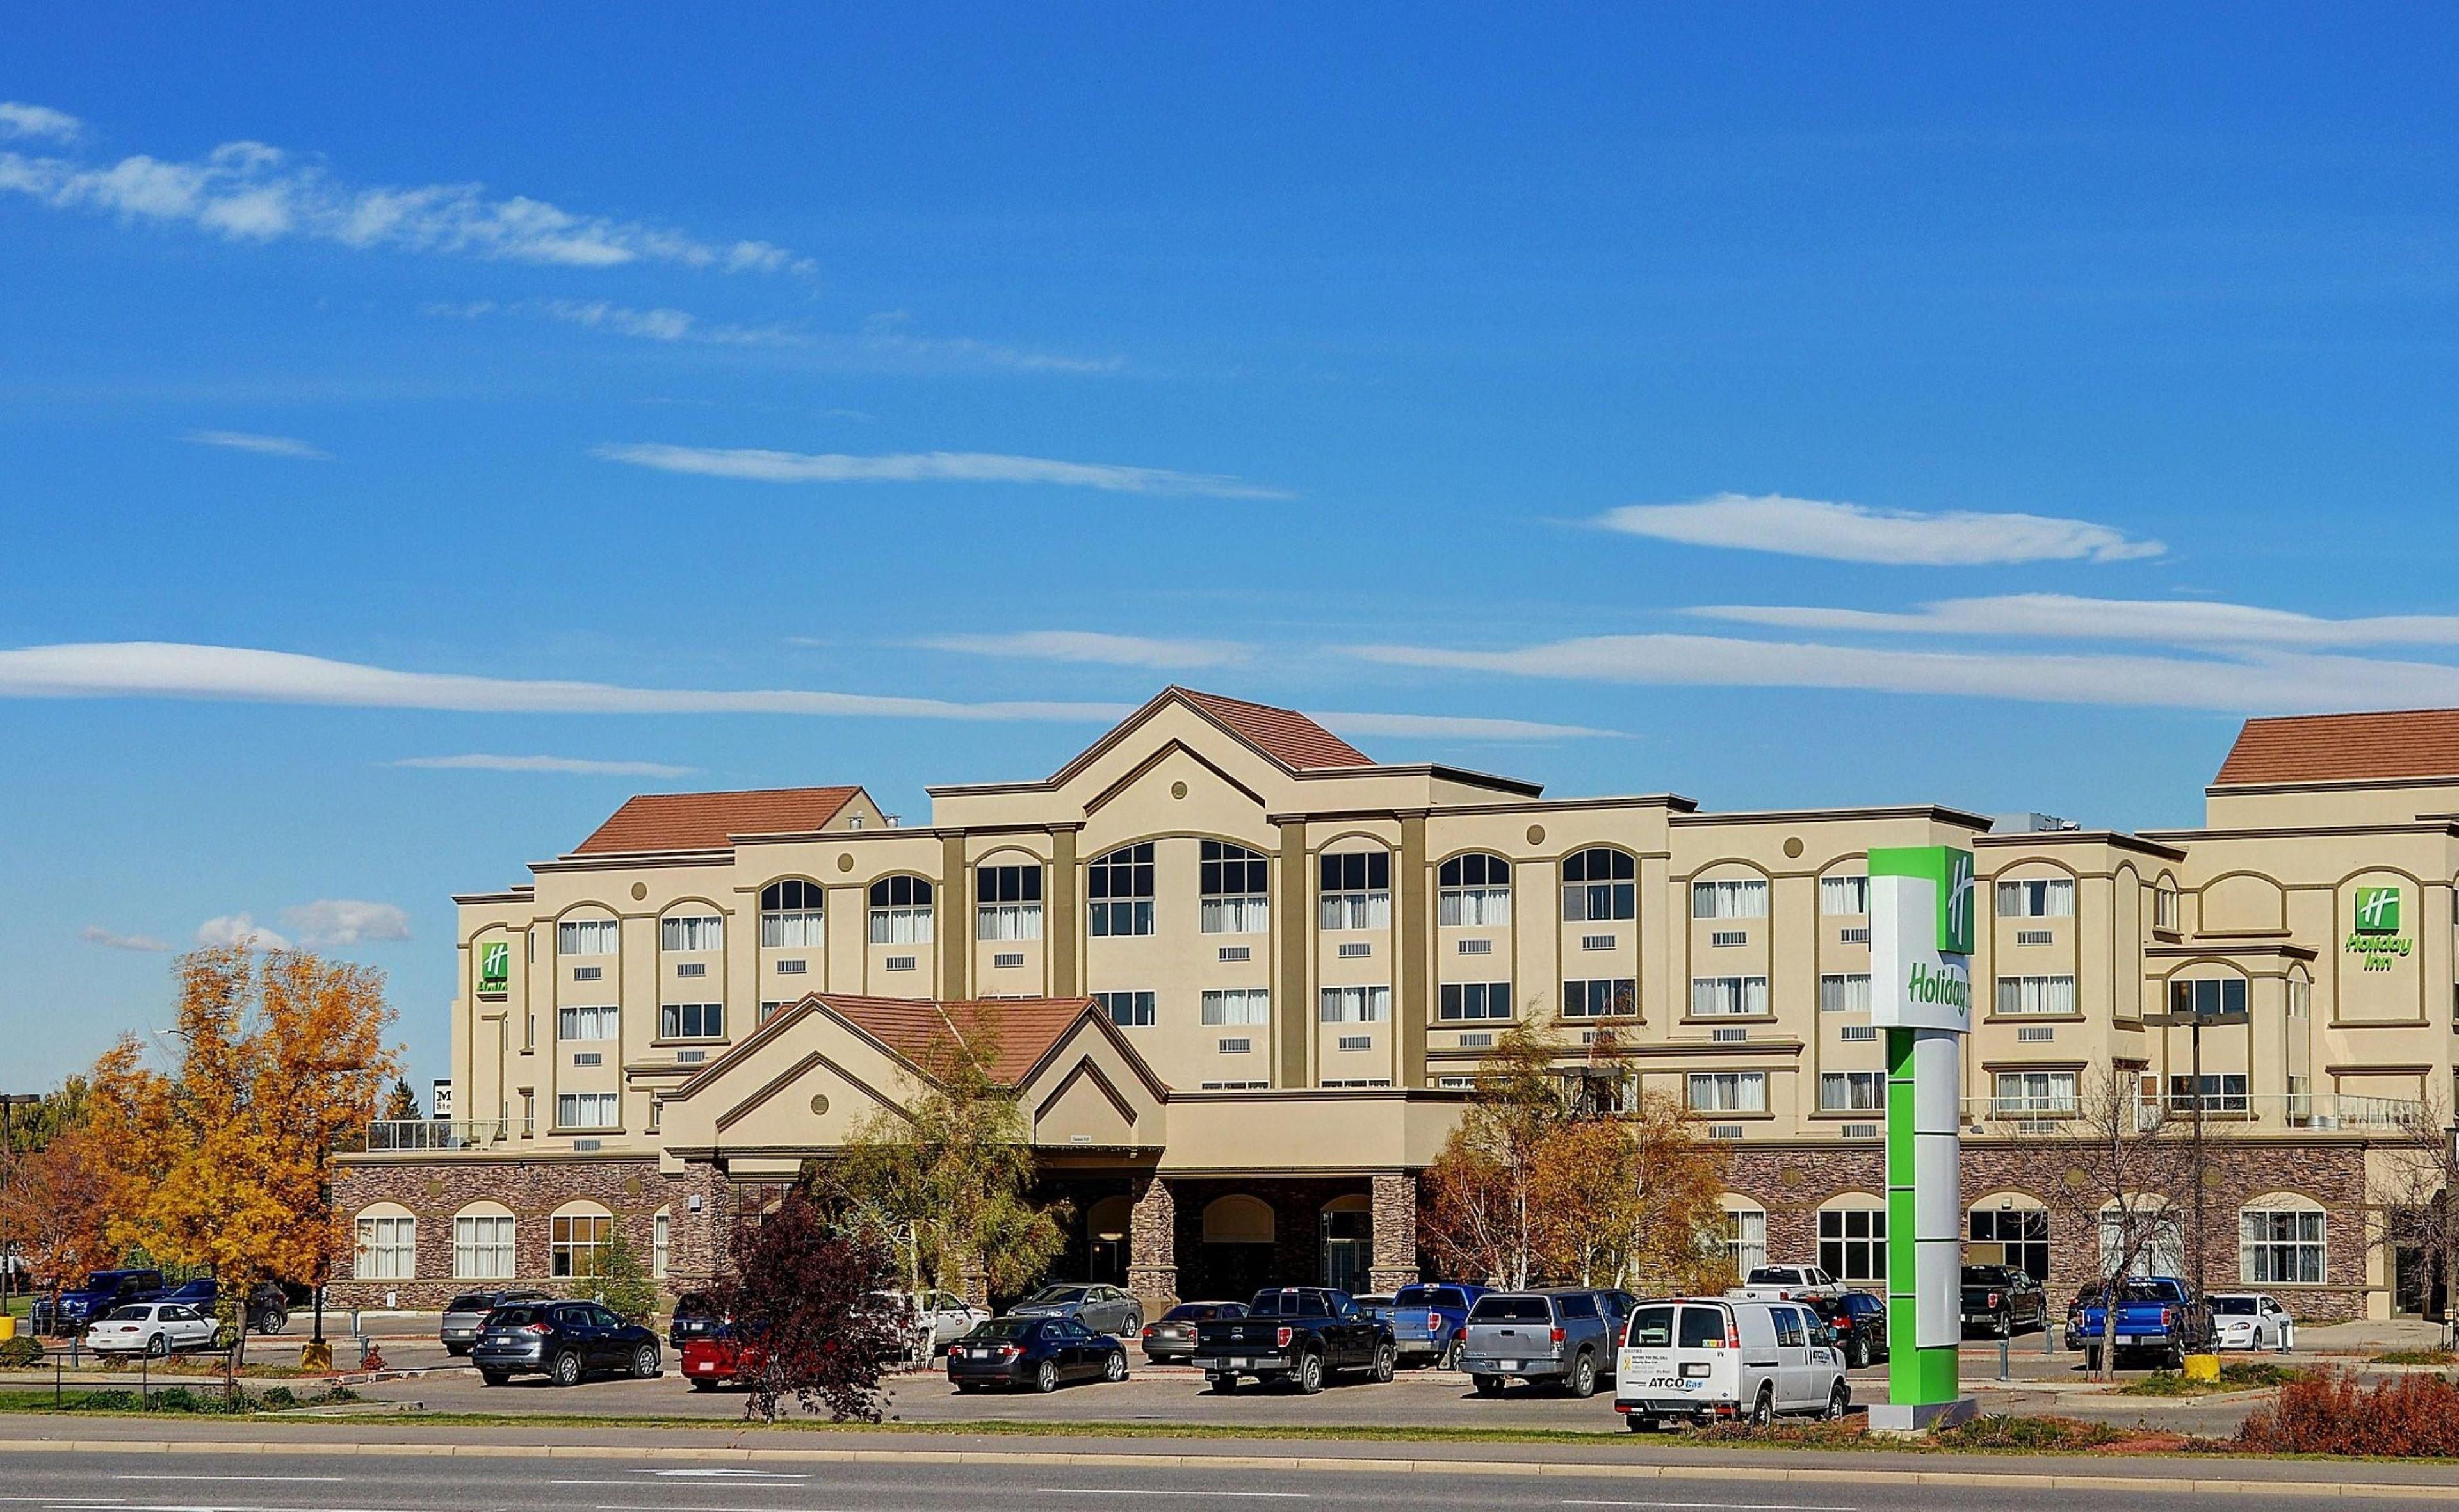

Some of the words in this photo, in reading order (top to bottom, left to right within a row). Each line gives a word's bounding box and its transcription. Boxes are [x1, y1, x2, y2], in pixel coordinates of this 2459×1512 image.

[2346, 933, 2413, 954] Holiday
[2364, 952, 2392, 969] Inn
[1908, 962, 1966, 1017] Holiday
[1648, 1378, 1685, 1388] ATCO
[1685, 1379, 1703, 1388] Gas
